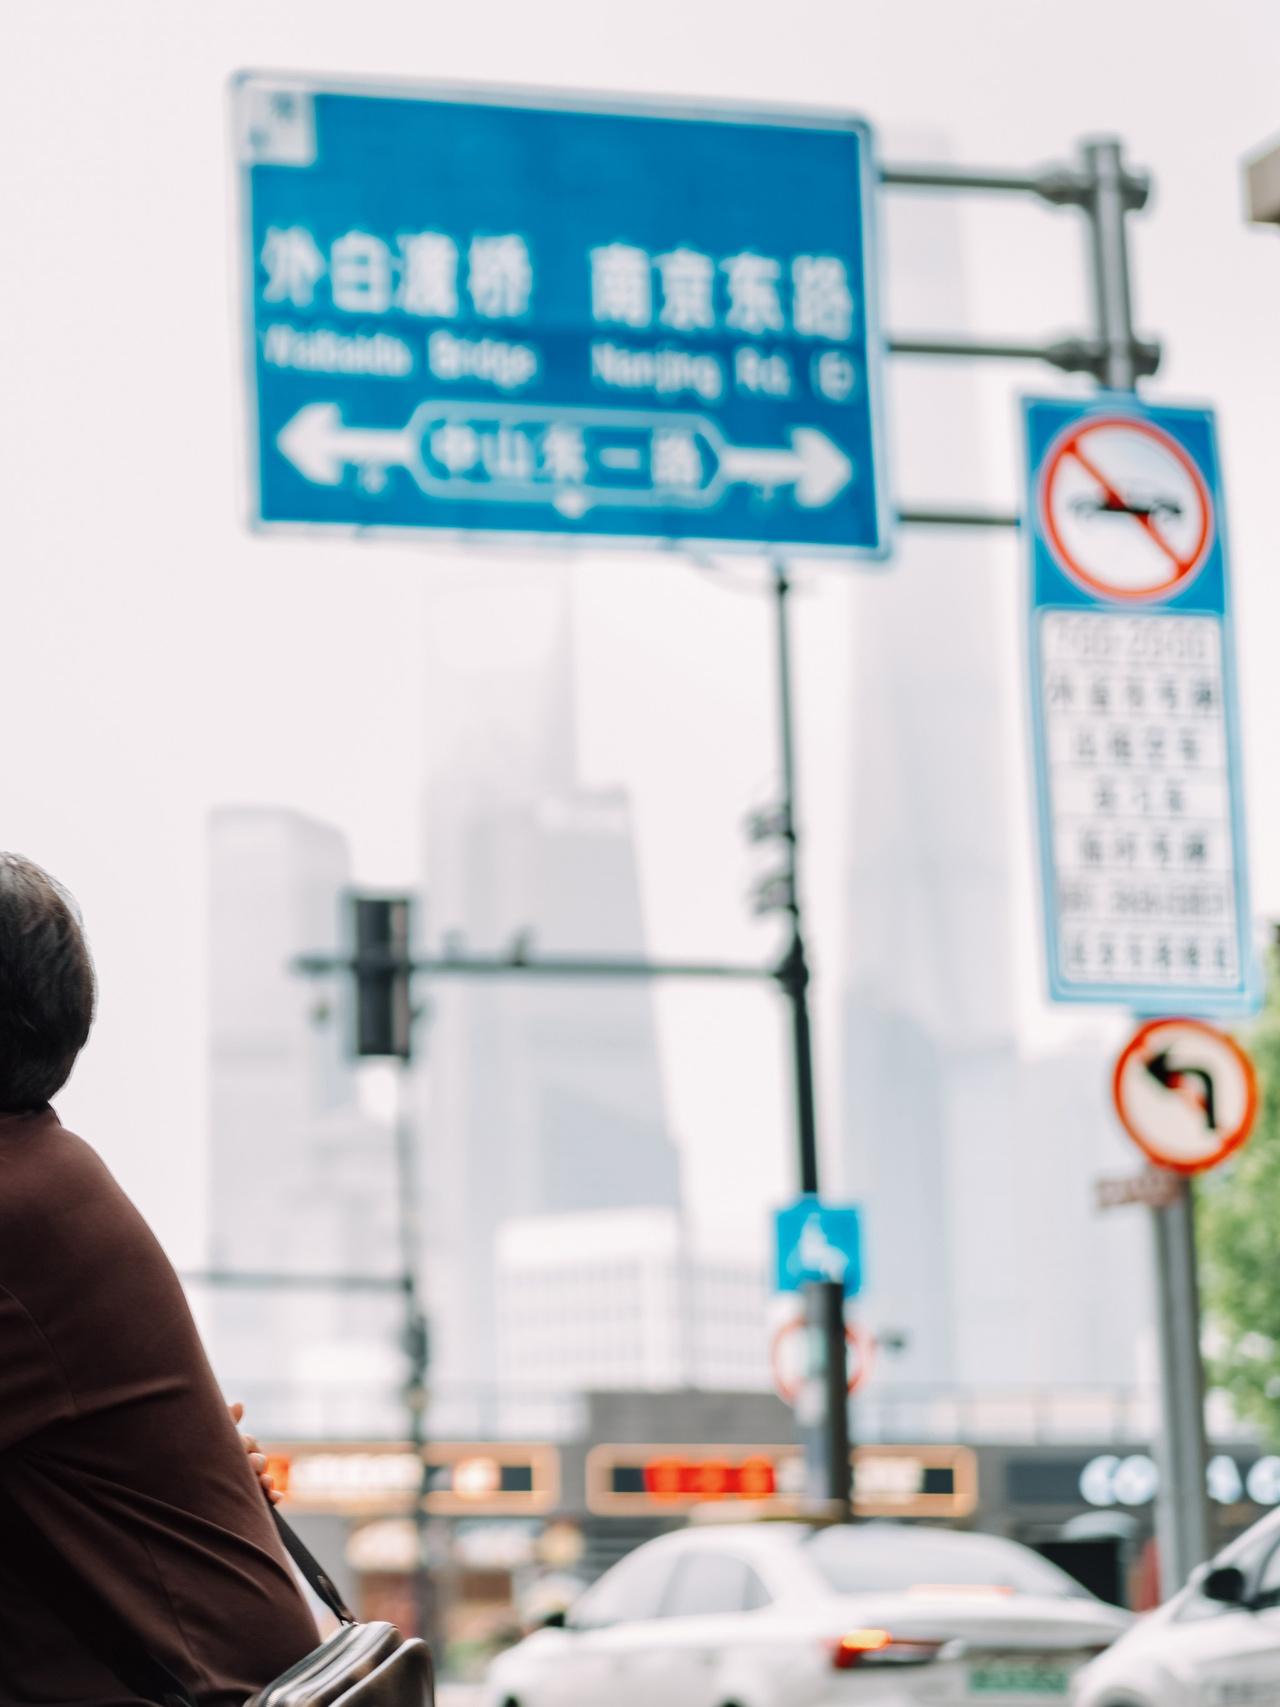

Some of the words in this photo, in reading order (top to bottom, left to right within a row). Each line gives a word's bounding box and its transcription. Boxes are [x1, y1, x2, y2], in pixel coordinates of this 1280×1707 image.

[590, 243, 853, 342] 南京东路
[430, 422, 702, 490] 中山东一路
